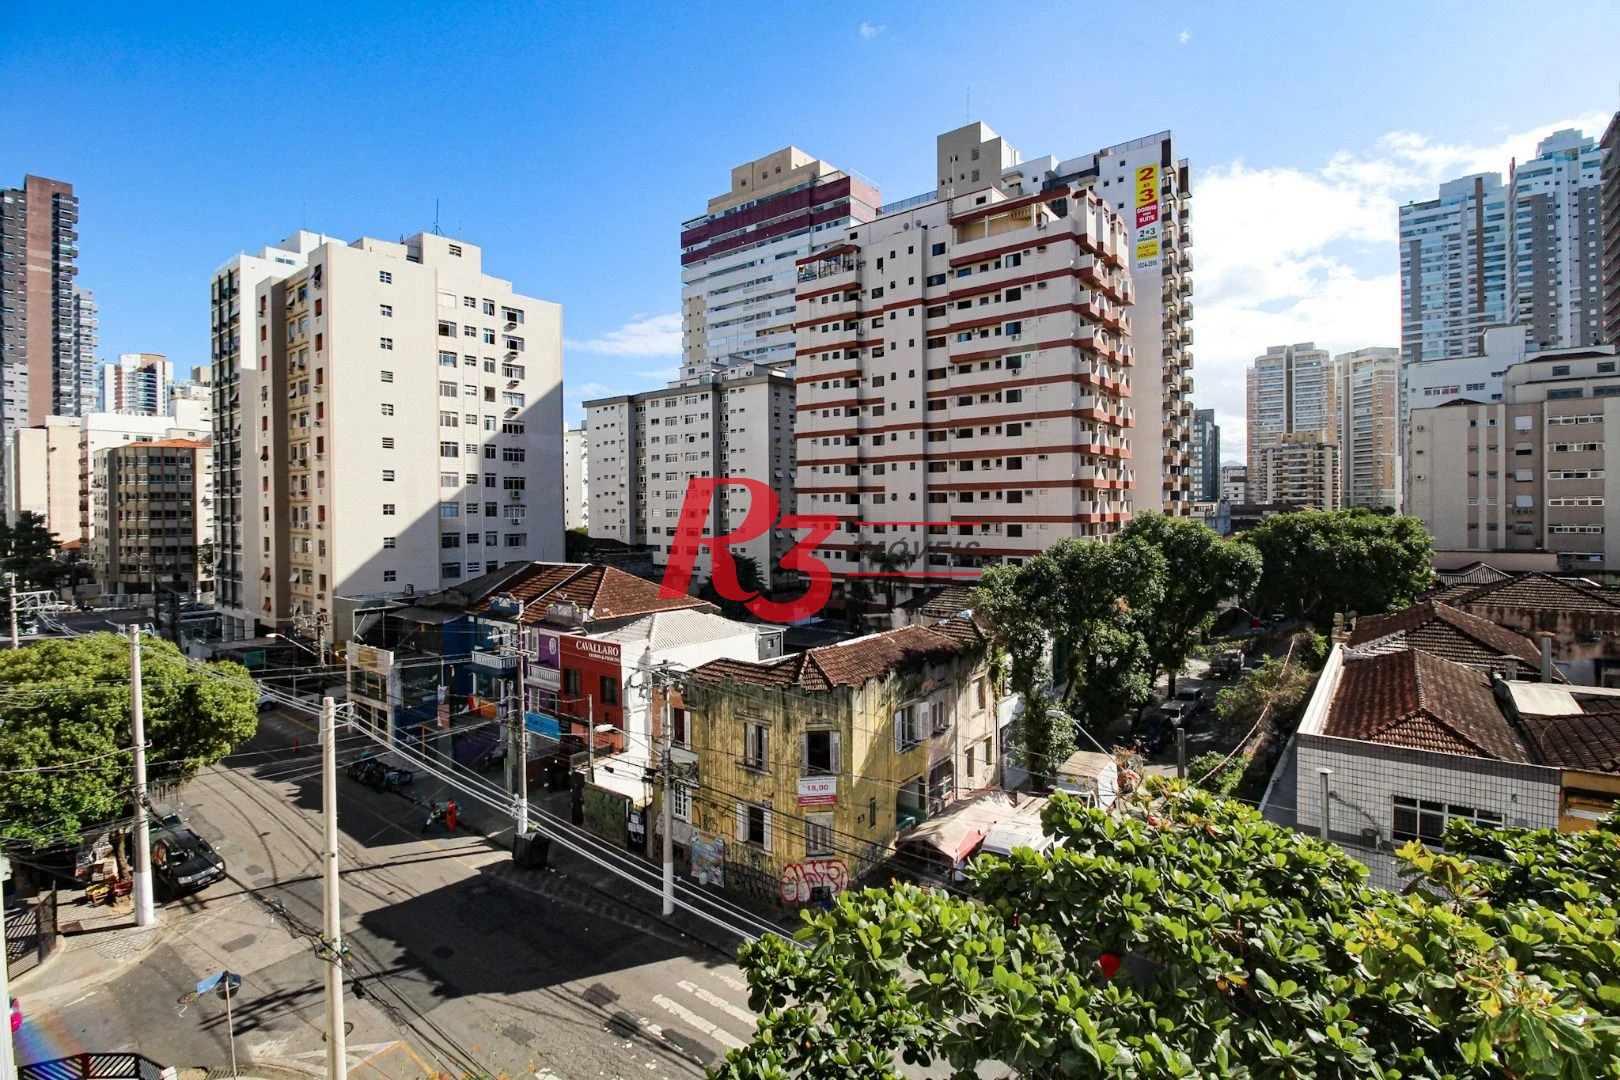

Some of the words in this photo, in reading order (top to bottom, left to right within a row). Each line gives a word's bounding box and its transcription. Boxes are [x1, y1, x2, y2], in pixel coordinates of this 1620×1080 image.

[1139, 167, 1154, 181] 2
[1139, 188, 1154, 202] 3
[1139, 230, 1145, 238] 2
[1150, 227, 1156, 235] 3
[576, 640, 619, 656] CAVALLARO
